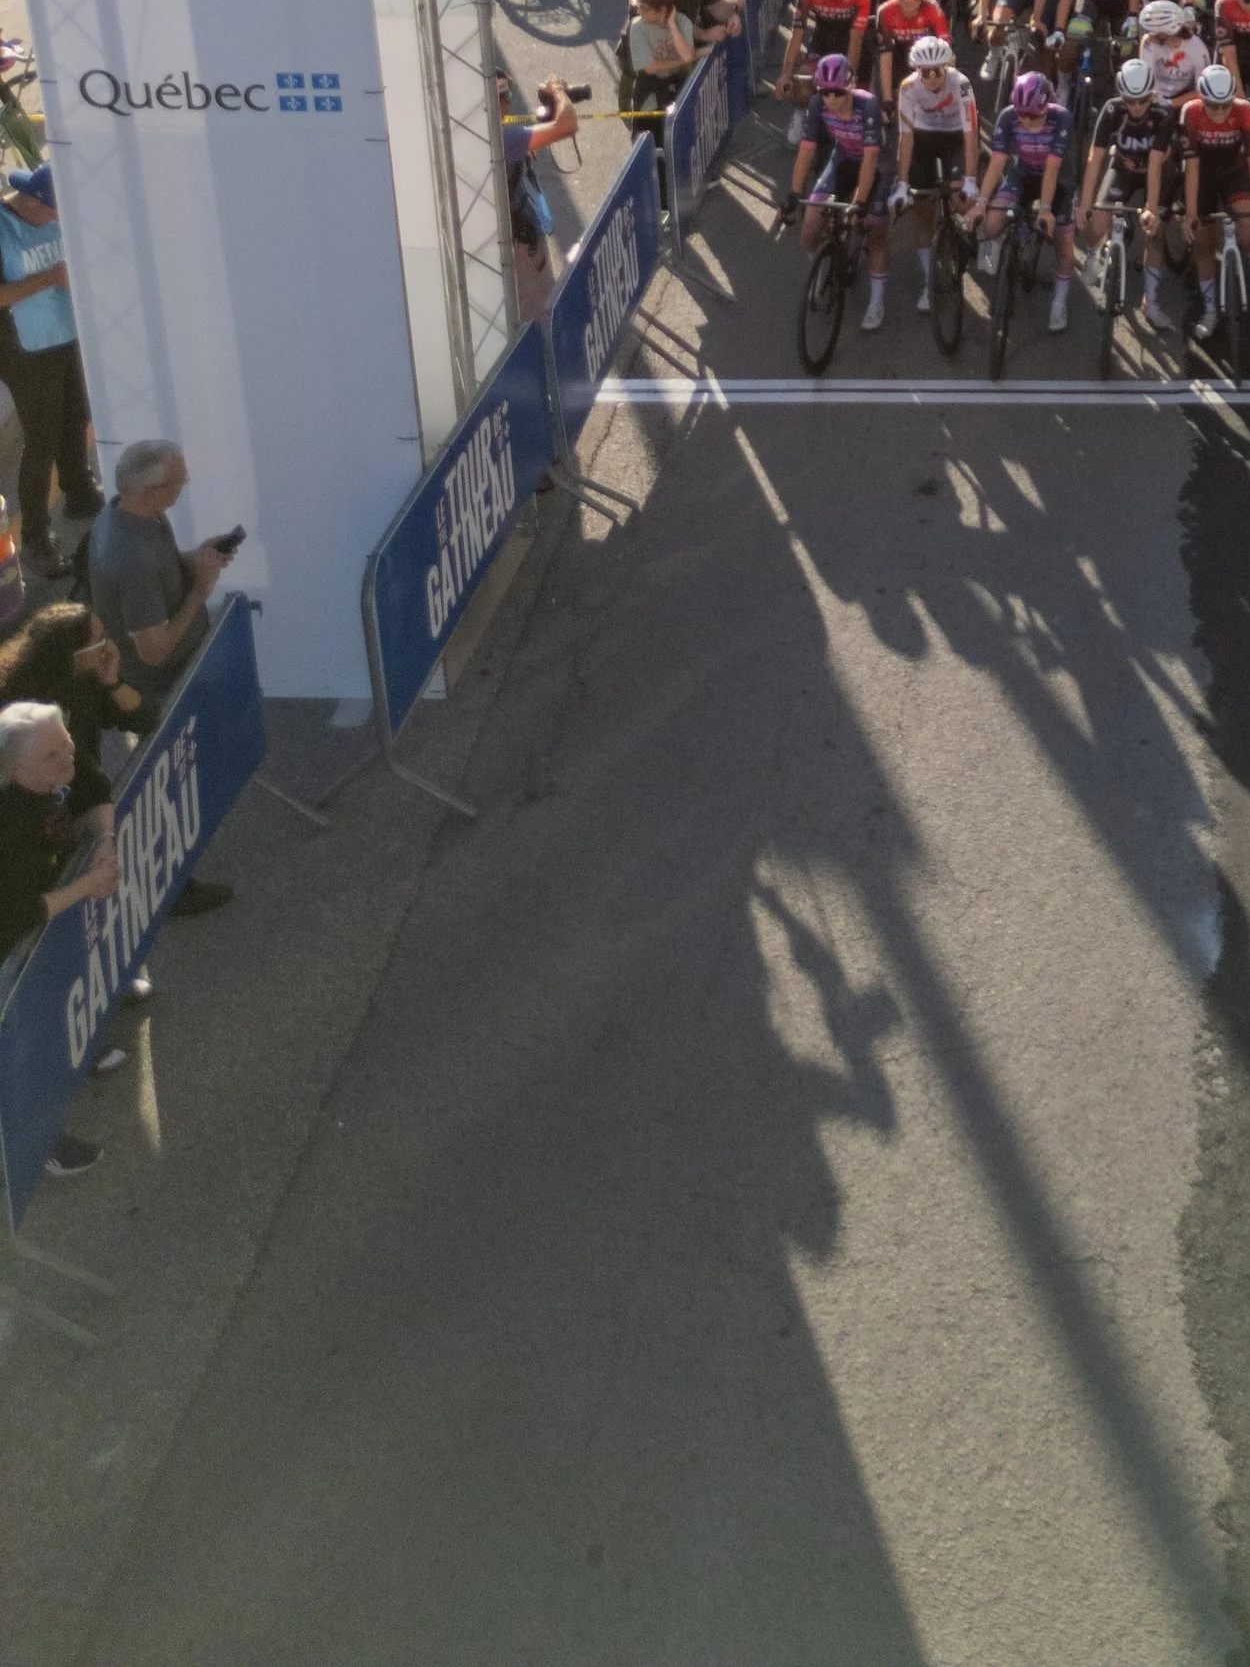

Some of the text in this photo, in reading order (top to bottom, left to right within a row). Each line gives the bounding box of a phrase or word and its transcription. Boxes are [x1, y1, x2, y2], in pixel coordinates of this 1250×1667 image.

[78, 69, 271, 117] Québec
[427, 440, 516, 639] GATINEAU
[445, 416, 496, 531] TOUR
[66, 761, 200, 1069] GATINEAU
